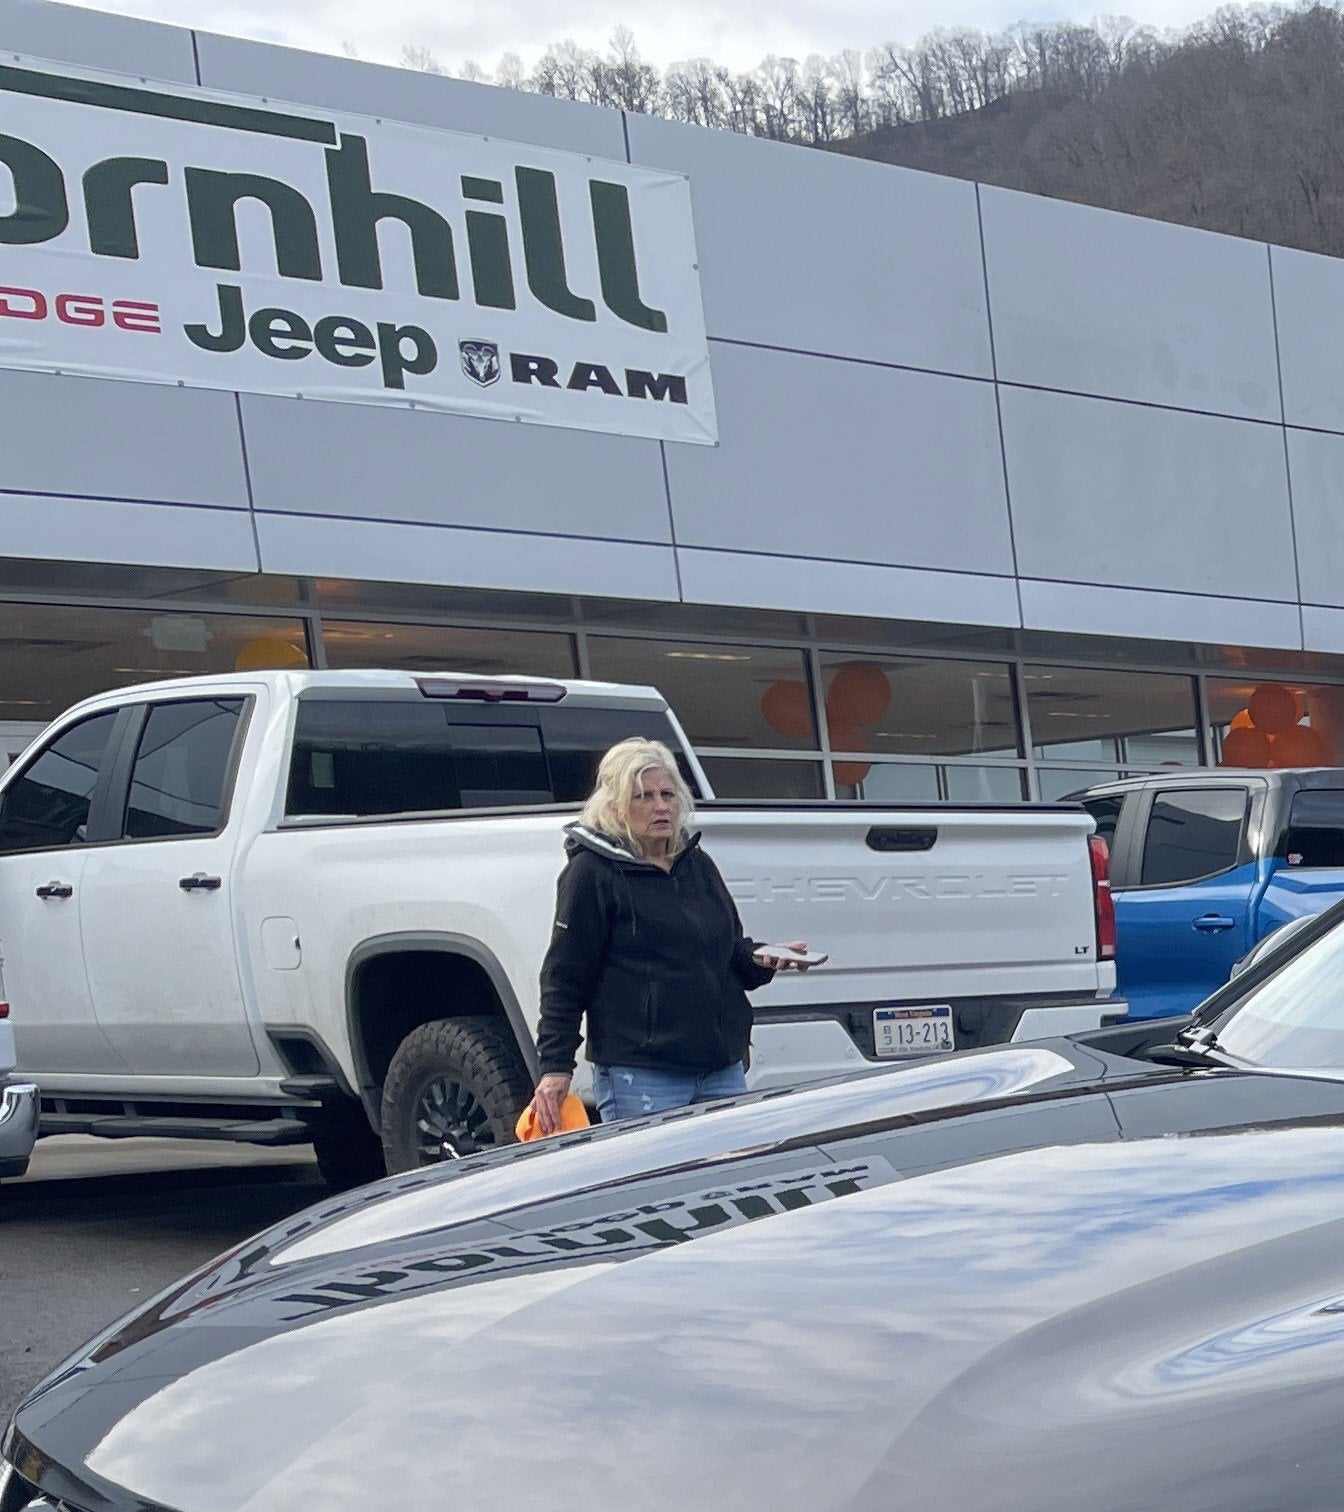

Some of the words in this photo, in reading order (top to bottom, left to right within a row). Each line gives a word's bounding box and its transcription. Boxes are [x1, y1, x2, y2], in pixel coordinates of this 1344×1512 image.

[183, 284, 438, 390] Jeep
[510, 351, 689, 405] RAM
[1074, 945, 1091, 956] LT
[898, 1021, 949, 1045] 13-213
